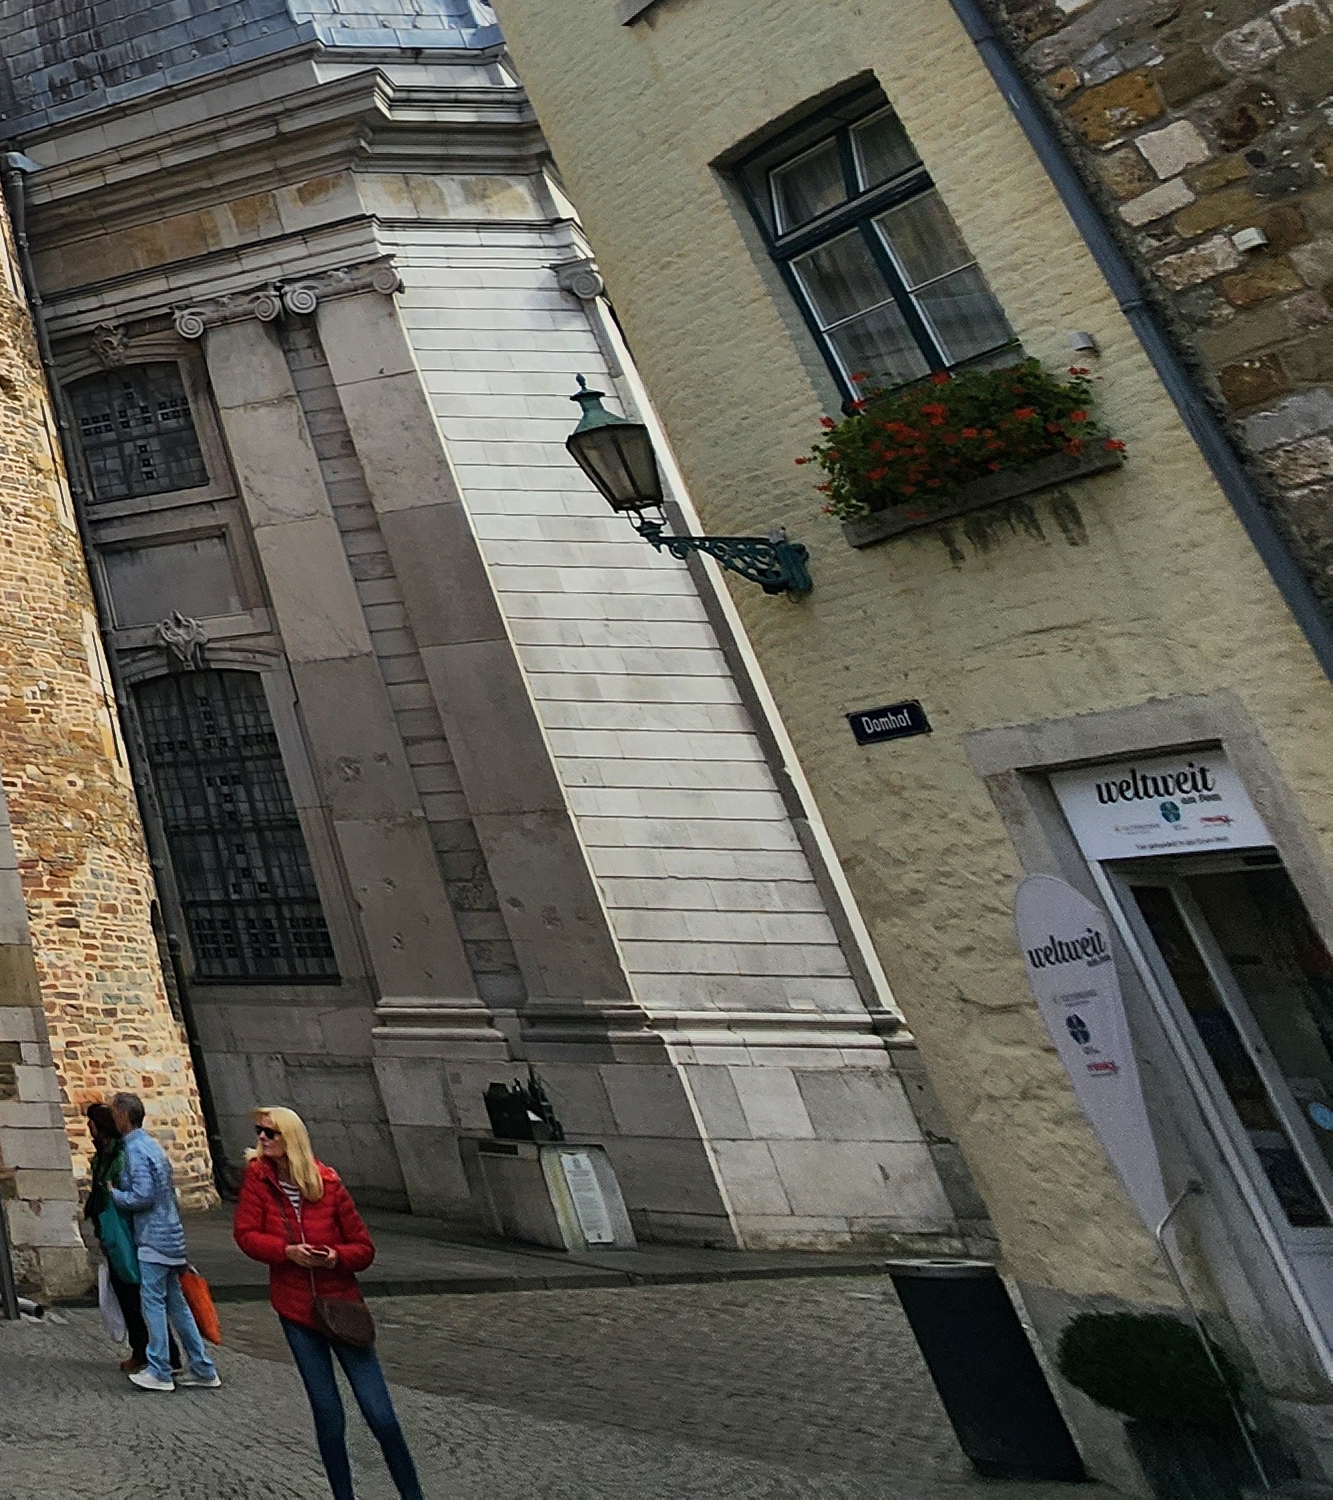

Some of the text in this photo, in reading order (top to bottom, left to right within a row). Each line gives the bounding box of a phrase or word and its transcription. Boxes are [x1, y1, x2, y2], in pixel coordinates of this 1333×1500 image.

[861, 709, 912, 734] Domhof
[1095, 762, 1217, 805] weltweit
[1027, 927, 1107, 968] weltweit
